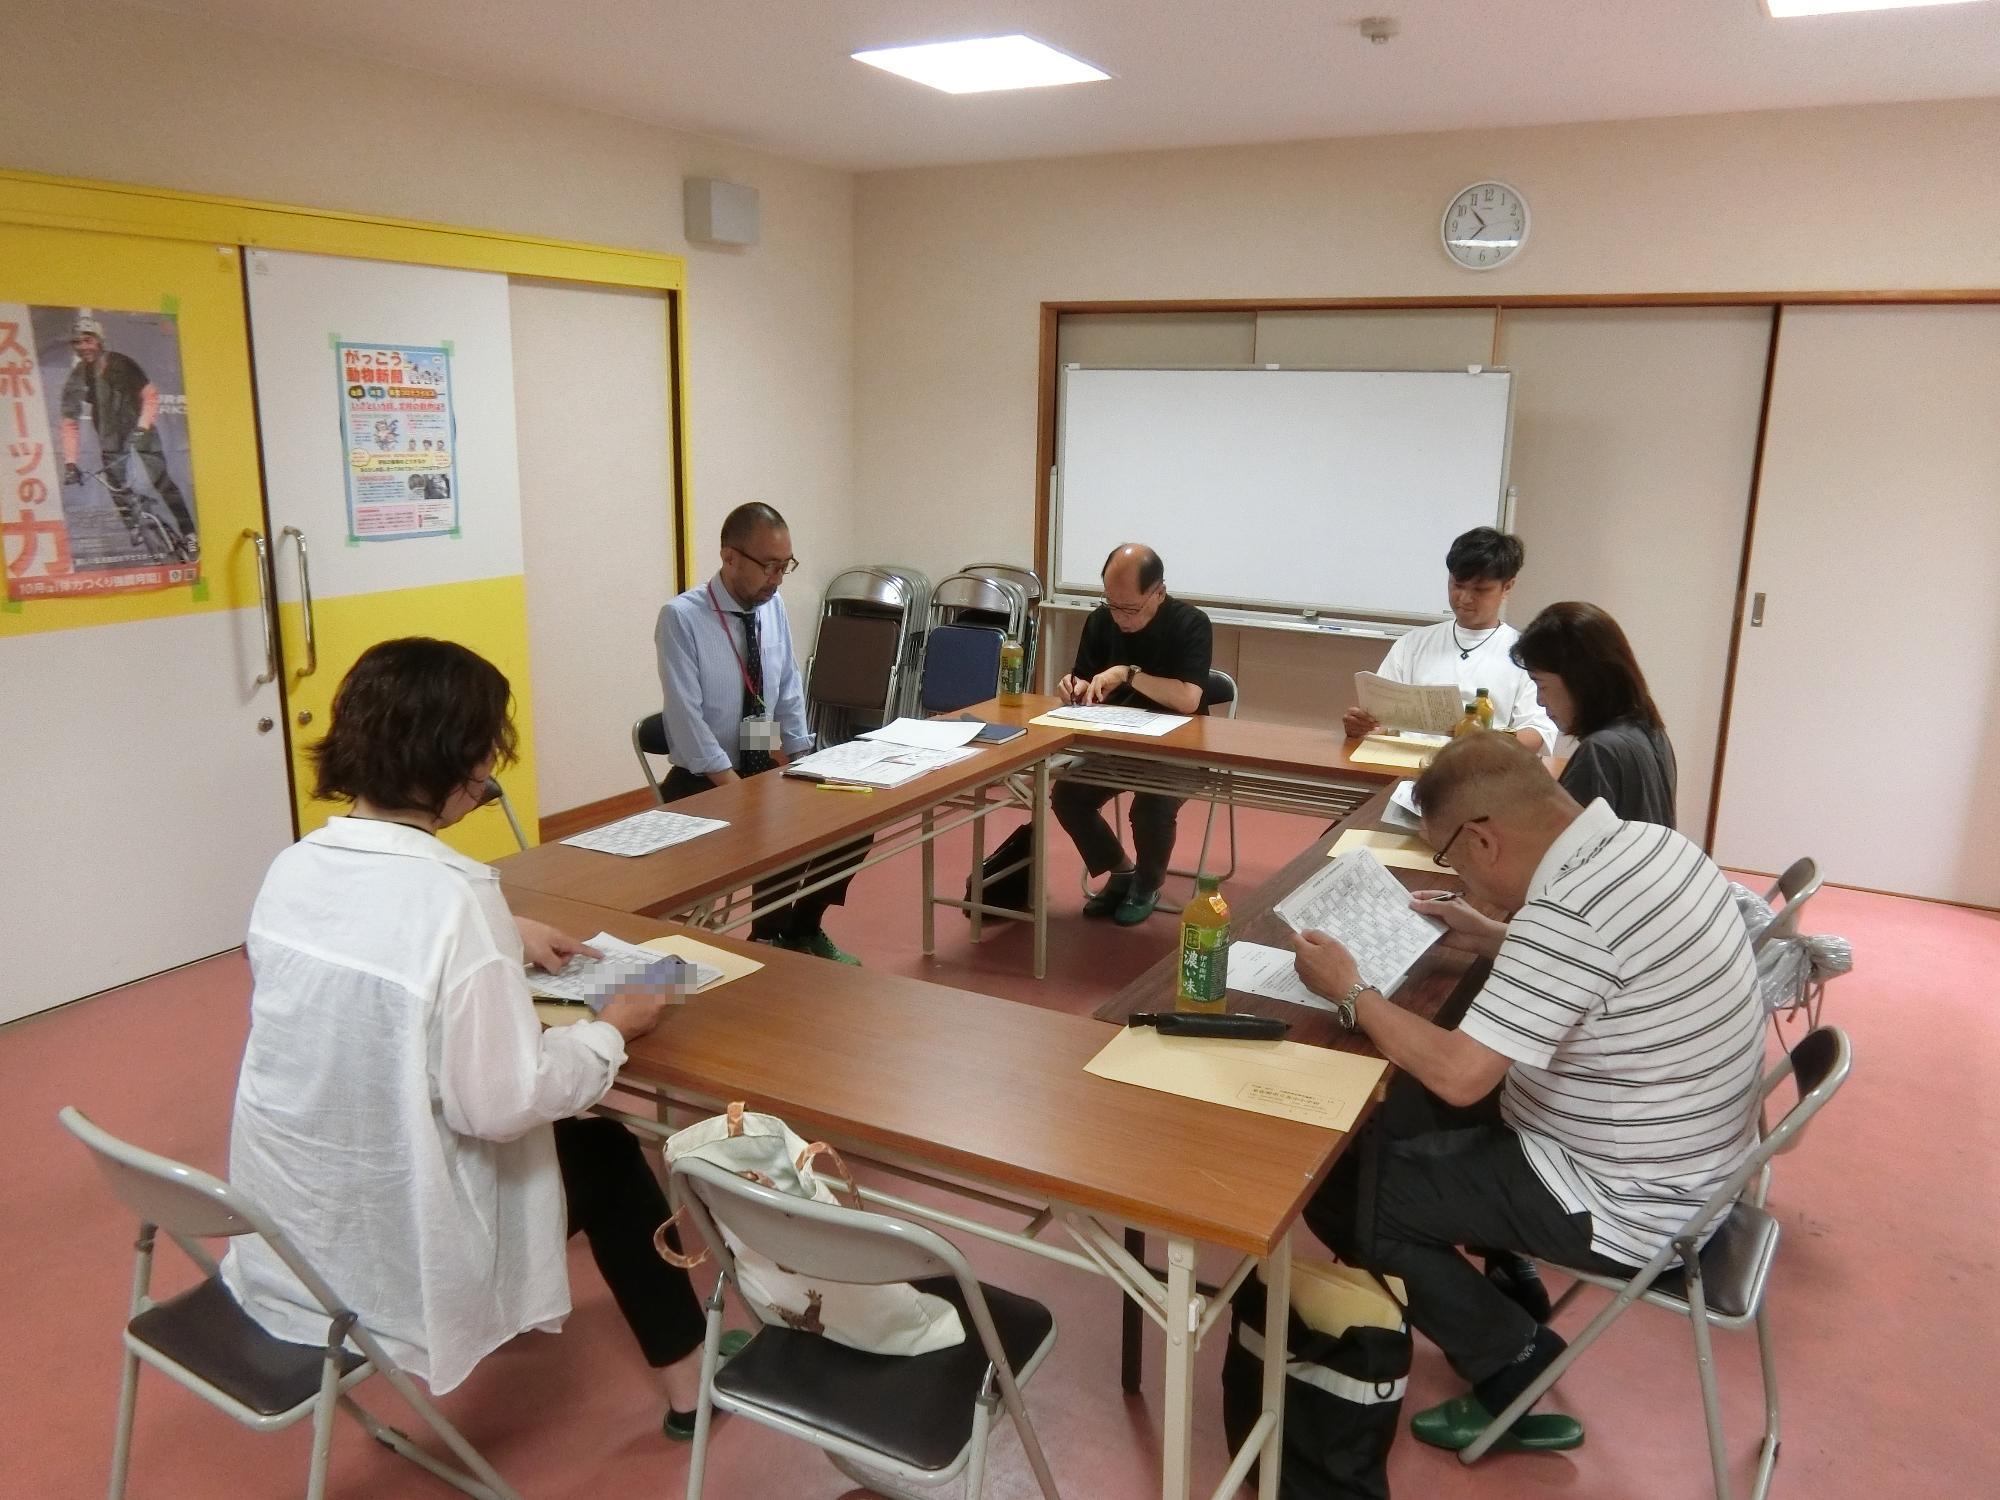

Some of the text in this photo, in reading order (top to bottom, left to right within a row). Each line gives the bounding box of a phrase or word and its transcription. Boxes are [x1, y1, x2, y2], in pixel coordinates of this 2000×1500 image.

[1471, 193, 1478, 206] 11
[1485, 189, 1494, 201] 12
[1458, 205, 1467, 217] 10
[1510, 203, 1517, 216] 2
[1452, 220, 1458, 232] 9
[1479, 249, 1485, 262] 6
[345, 350, 402, 366] がっこう
[346, 367, 403, 384] 動物新聞
[1183, 950, 1199, 994] 濃い味
